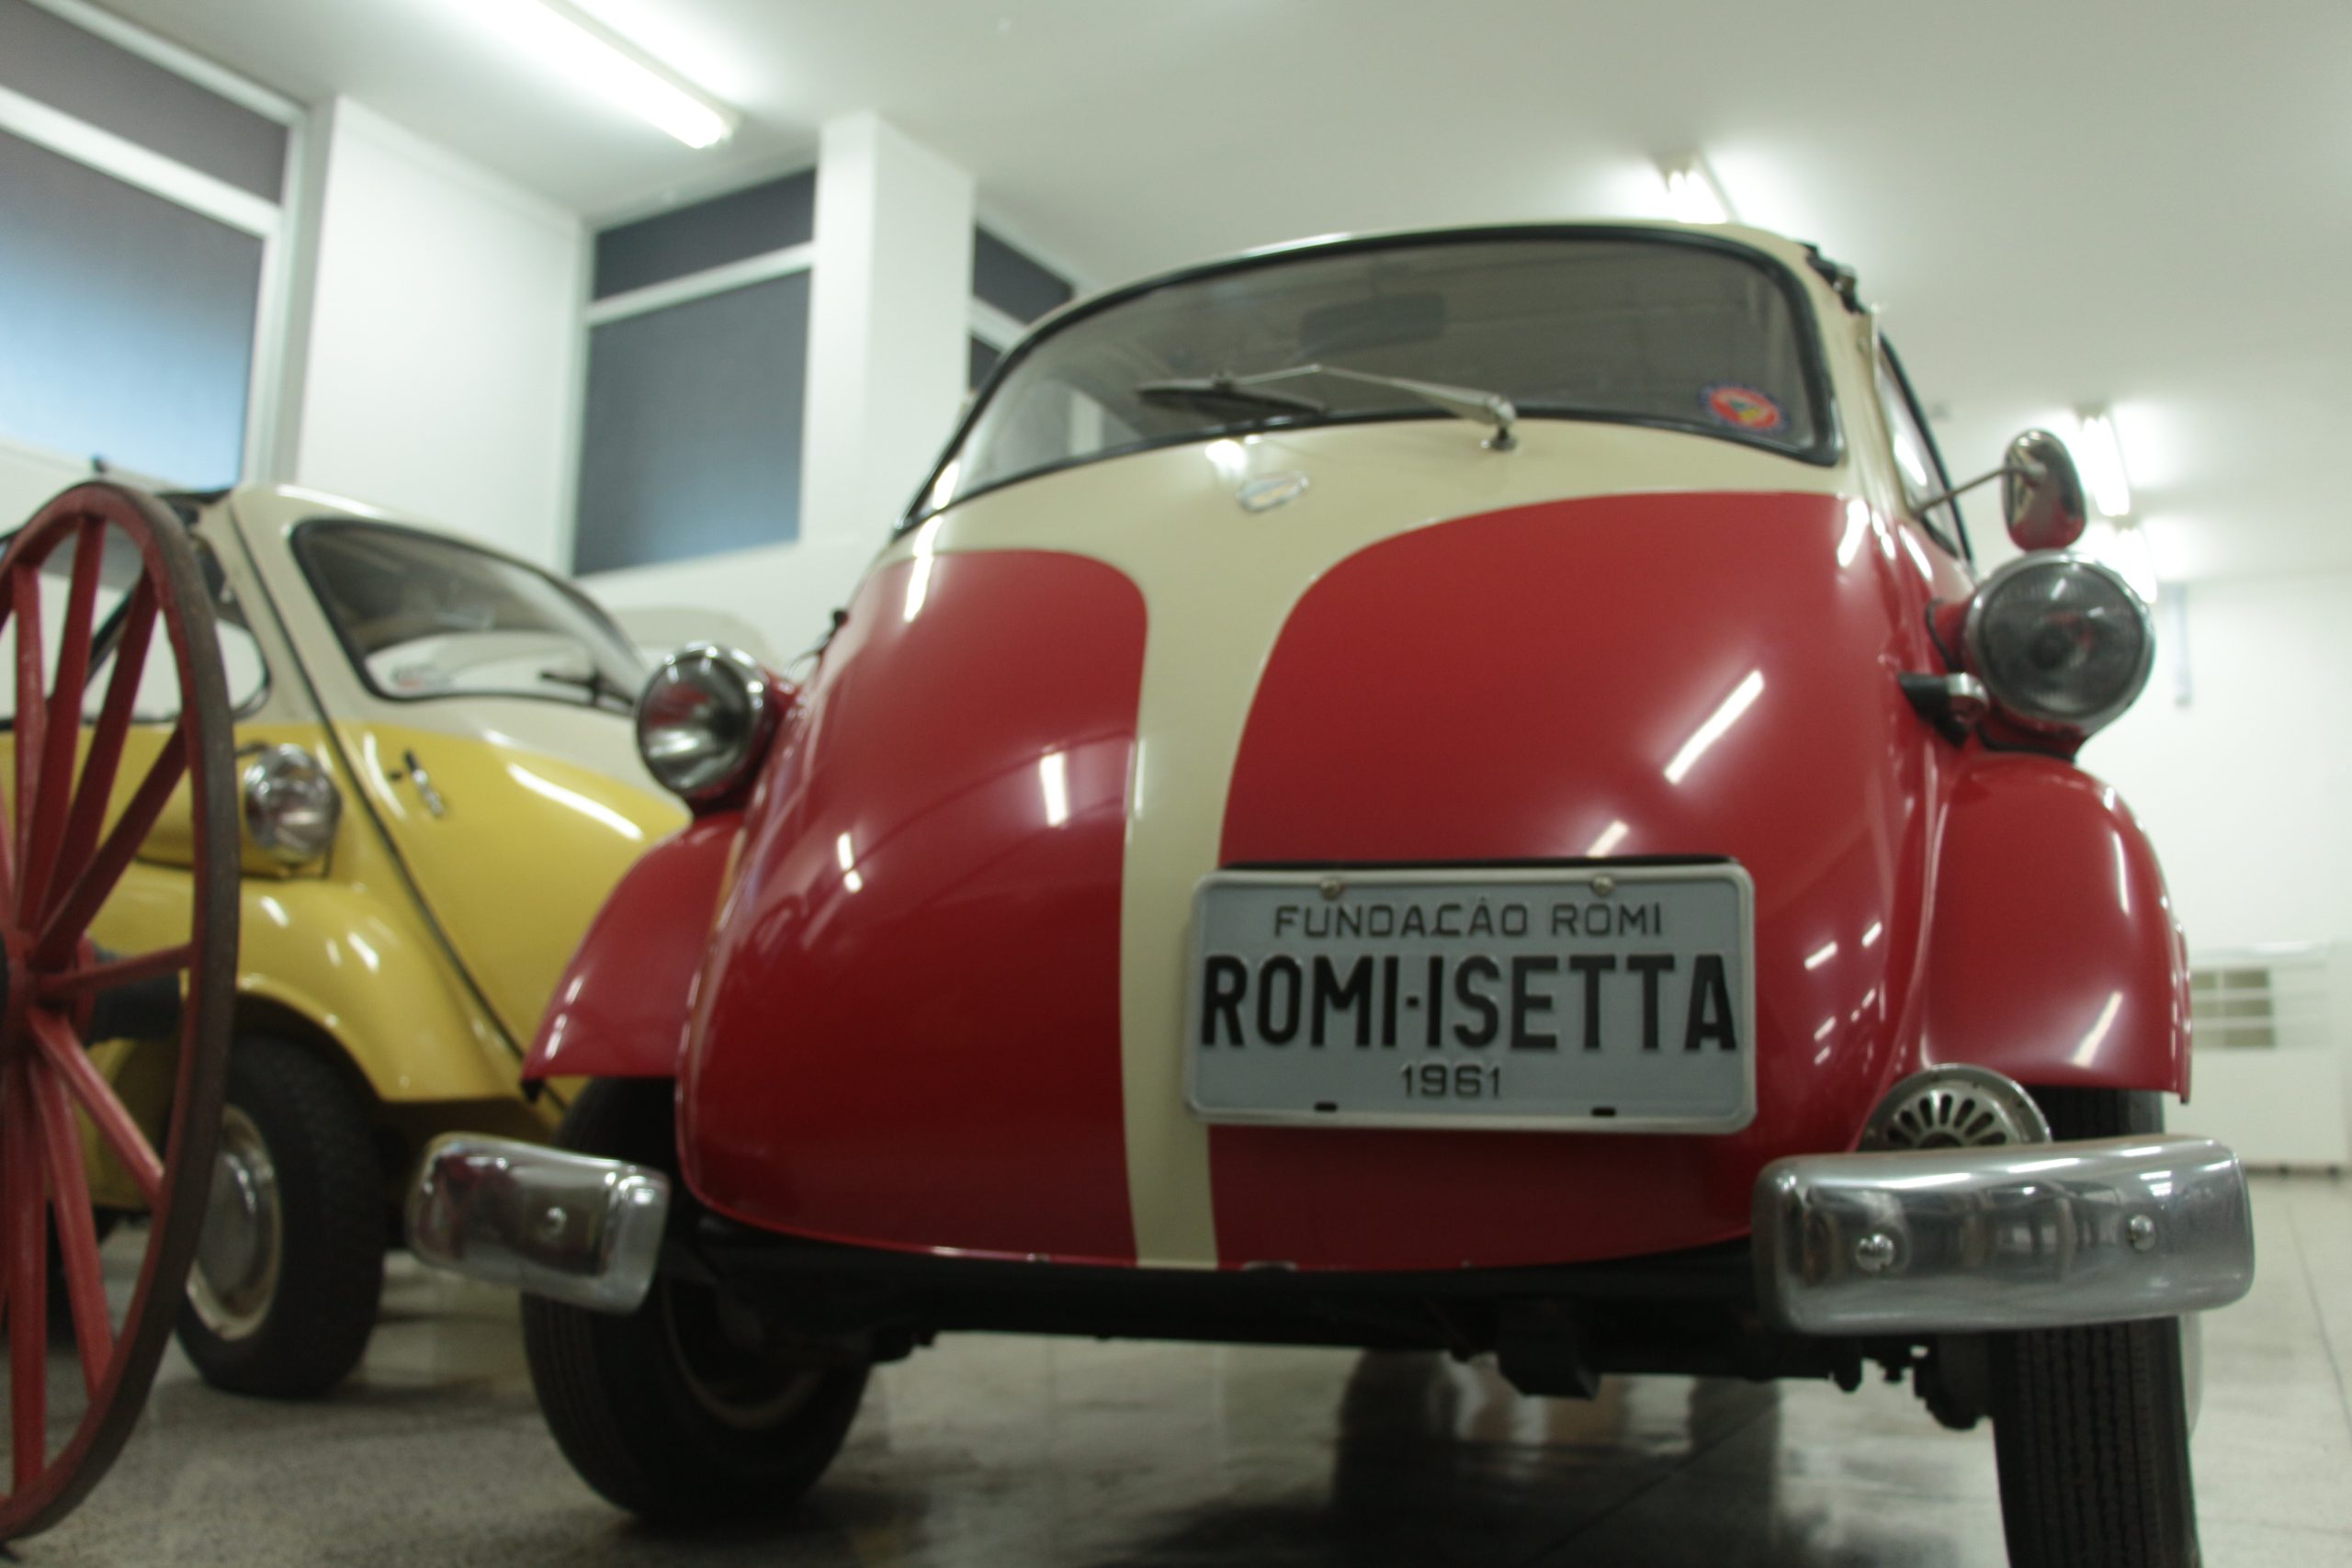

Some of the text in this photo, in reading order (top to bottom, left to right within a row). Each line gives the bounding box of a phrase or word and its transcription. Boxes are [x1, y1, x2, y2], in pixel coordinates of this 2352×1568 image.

[1550, 902, 1661, 937] ROMI
[1201, 954, 1737, 1051] ROMI-ISETTA
[1401, 1064, 1500, 1099] 1961
